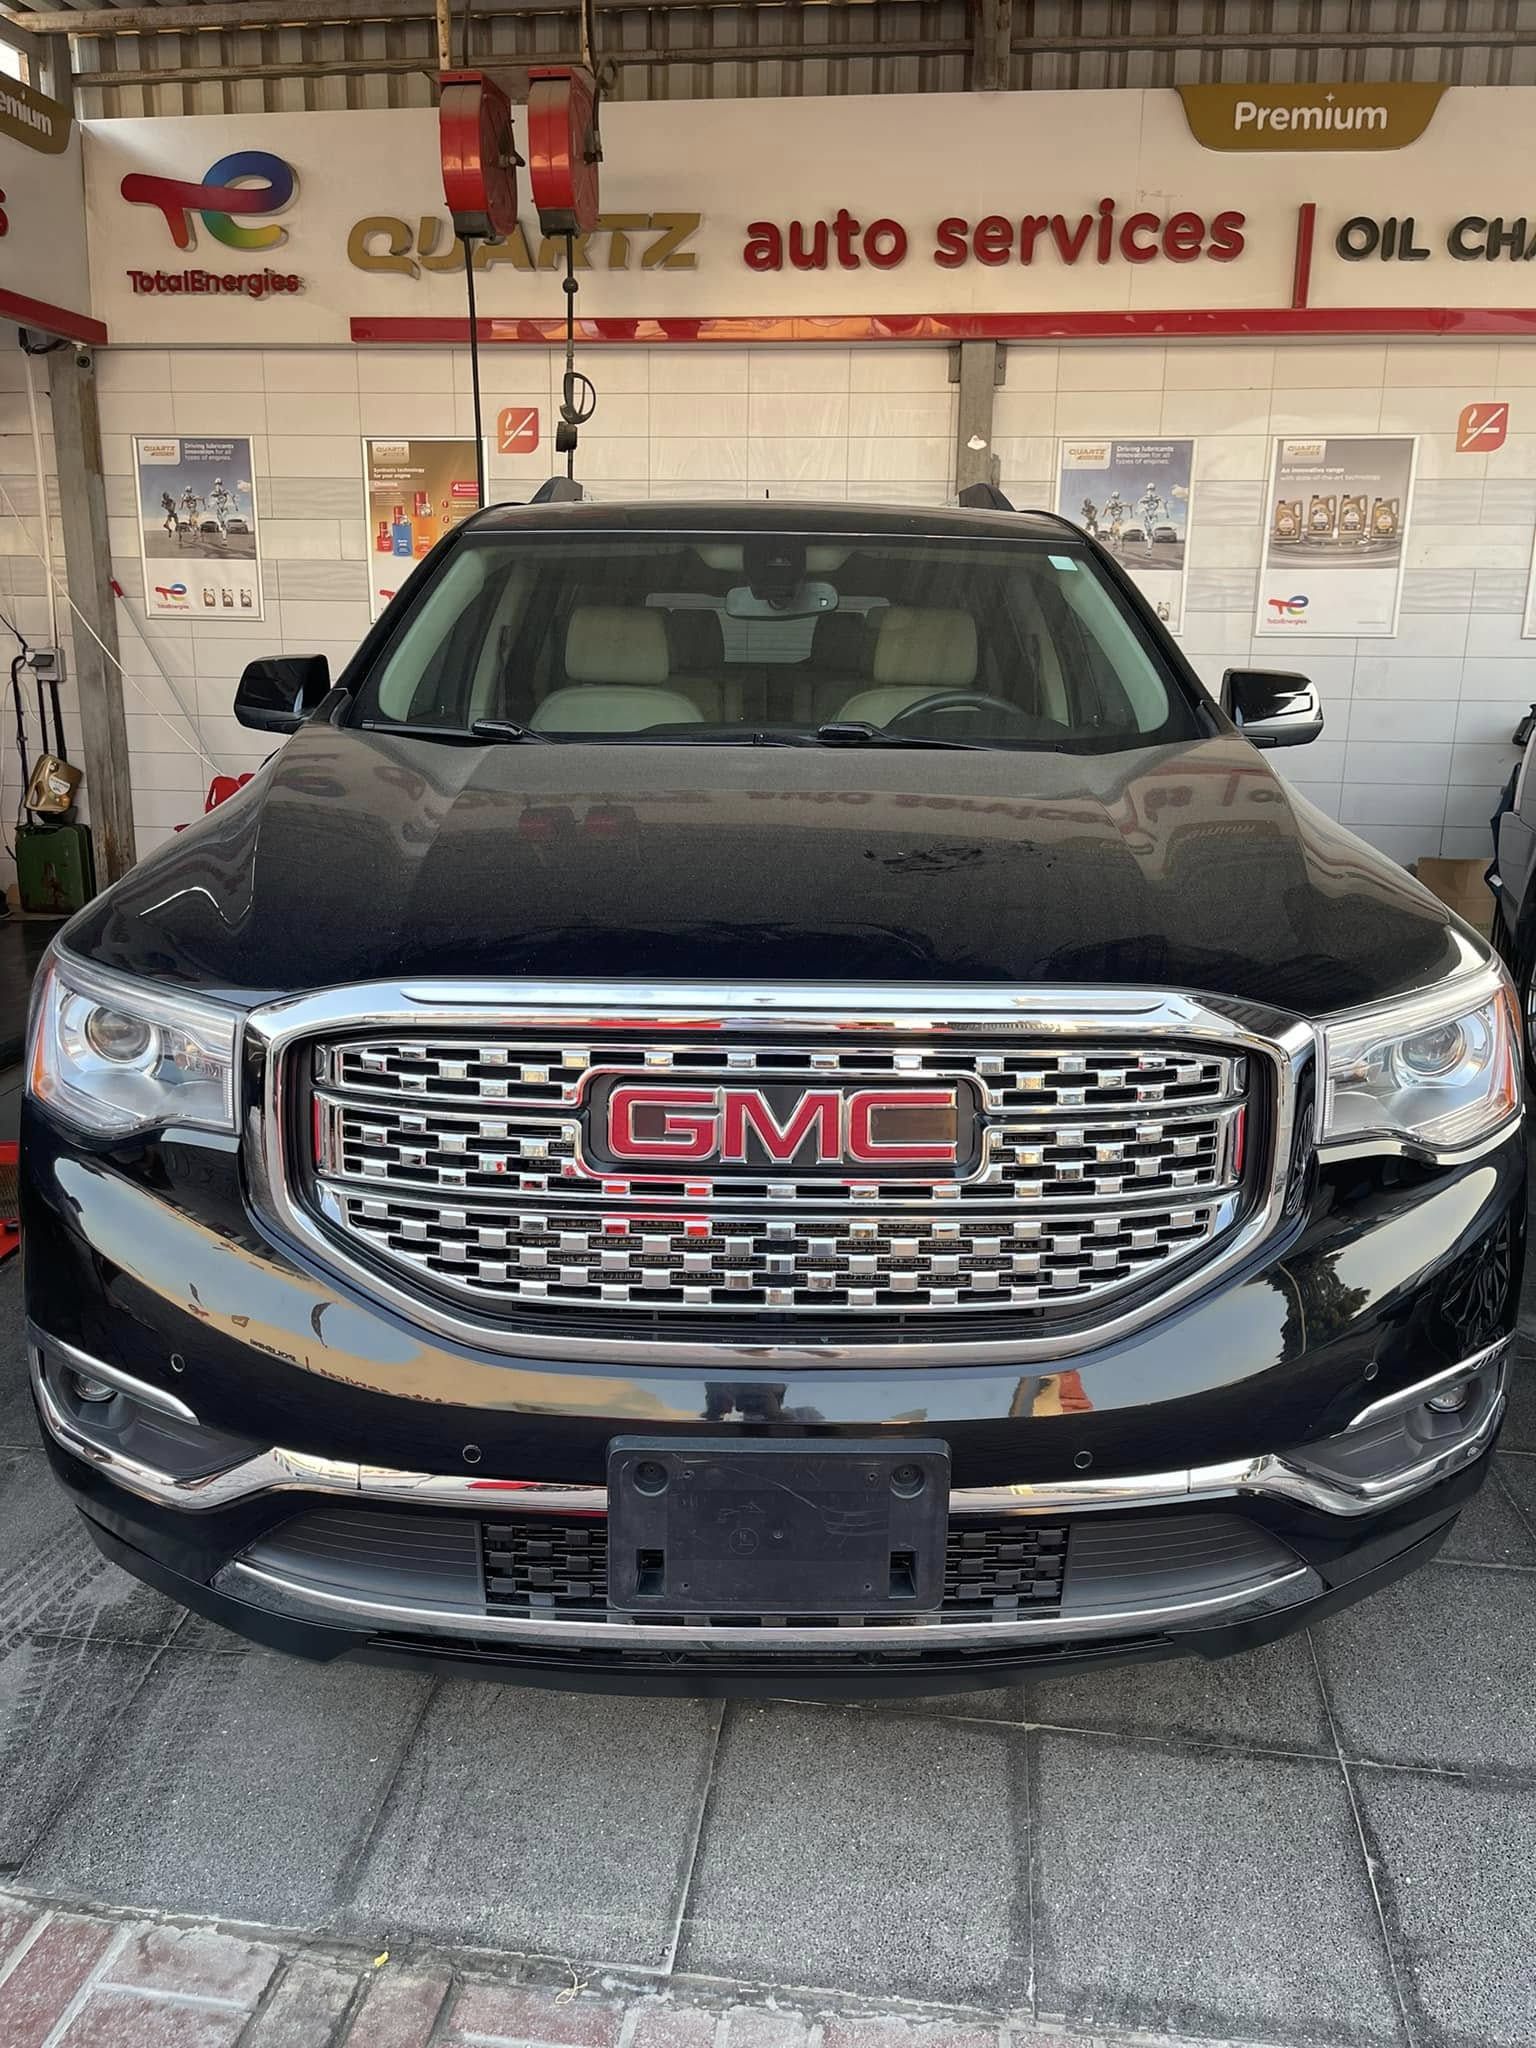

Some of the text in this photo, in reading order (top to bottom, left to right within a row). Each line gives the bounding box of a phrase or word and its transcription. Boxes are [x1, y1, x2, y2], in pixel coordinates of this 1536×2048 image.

[1233, 92, 1388, 131] Premium
[743, 197, 1246, 271] auto services
[1335, 215, 1430, 262] OIL
[126, 268, 302, 298] TotalEnergies
[608, 1086, 957, 1164] GMC
